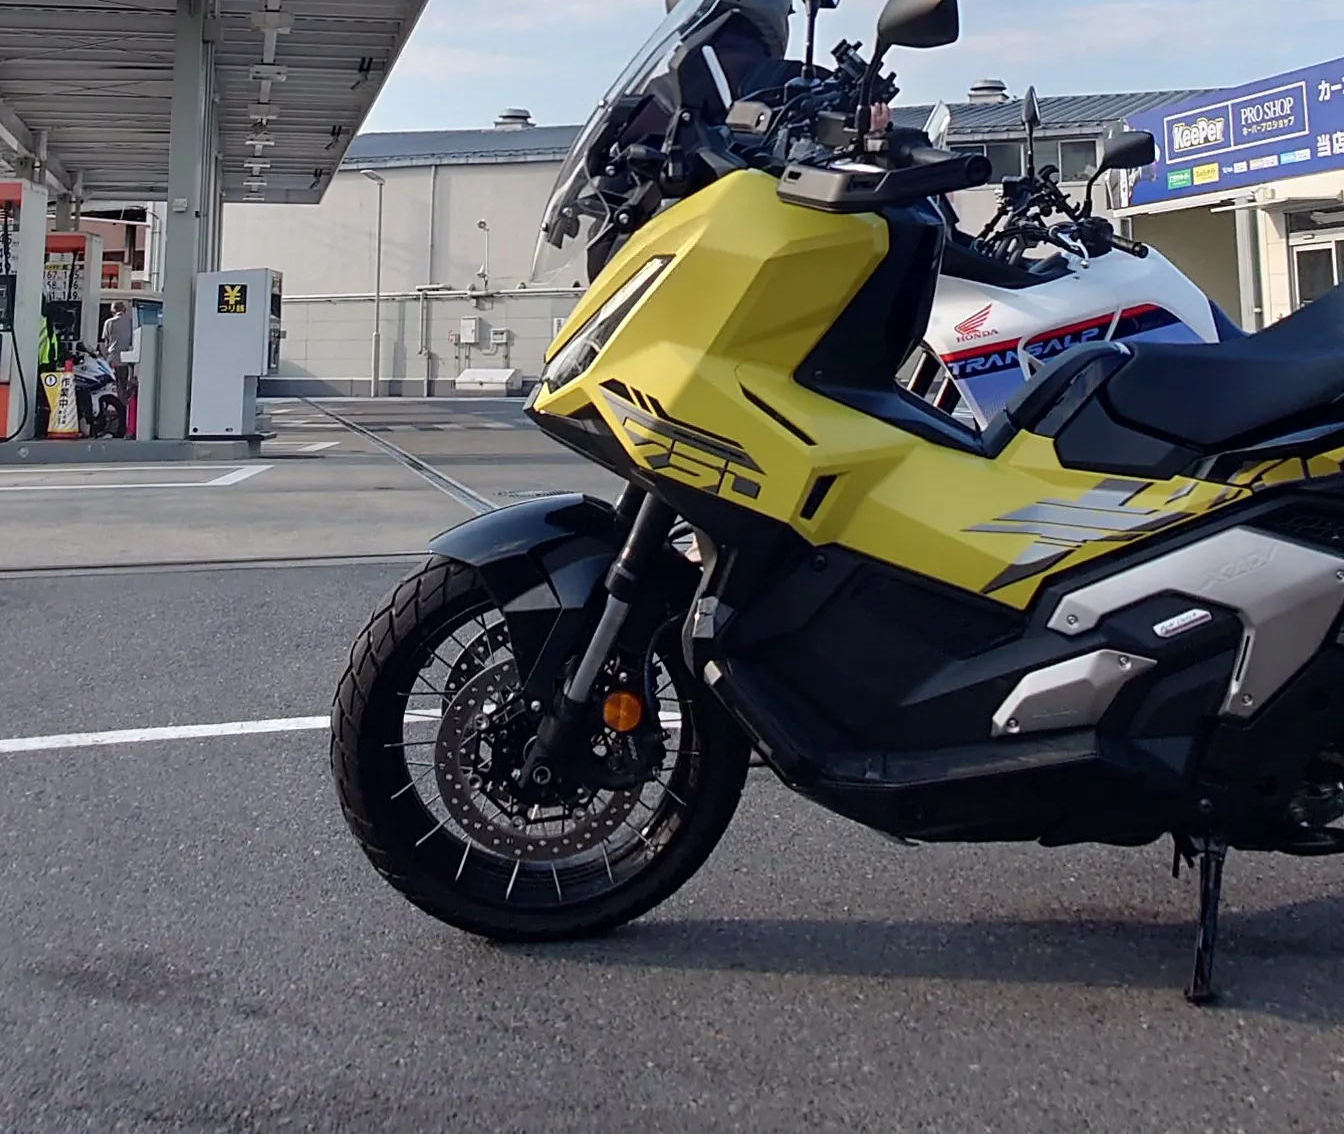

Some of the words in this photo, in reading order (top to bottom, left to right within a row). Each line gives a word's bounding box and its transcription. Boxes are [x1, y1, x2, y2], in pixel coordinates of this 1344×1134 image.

[1240, 105, 1264, 125] PRO
[1264, 97, 1294, 120] SHOP
[1172, 117, 1225, 152] KeePer
[956, 328, 999, 344] HONDA
